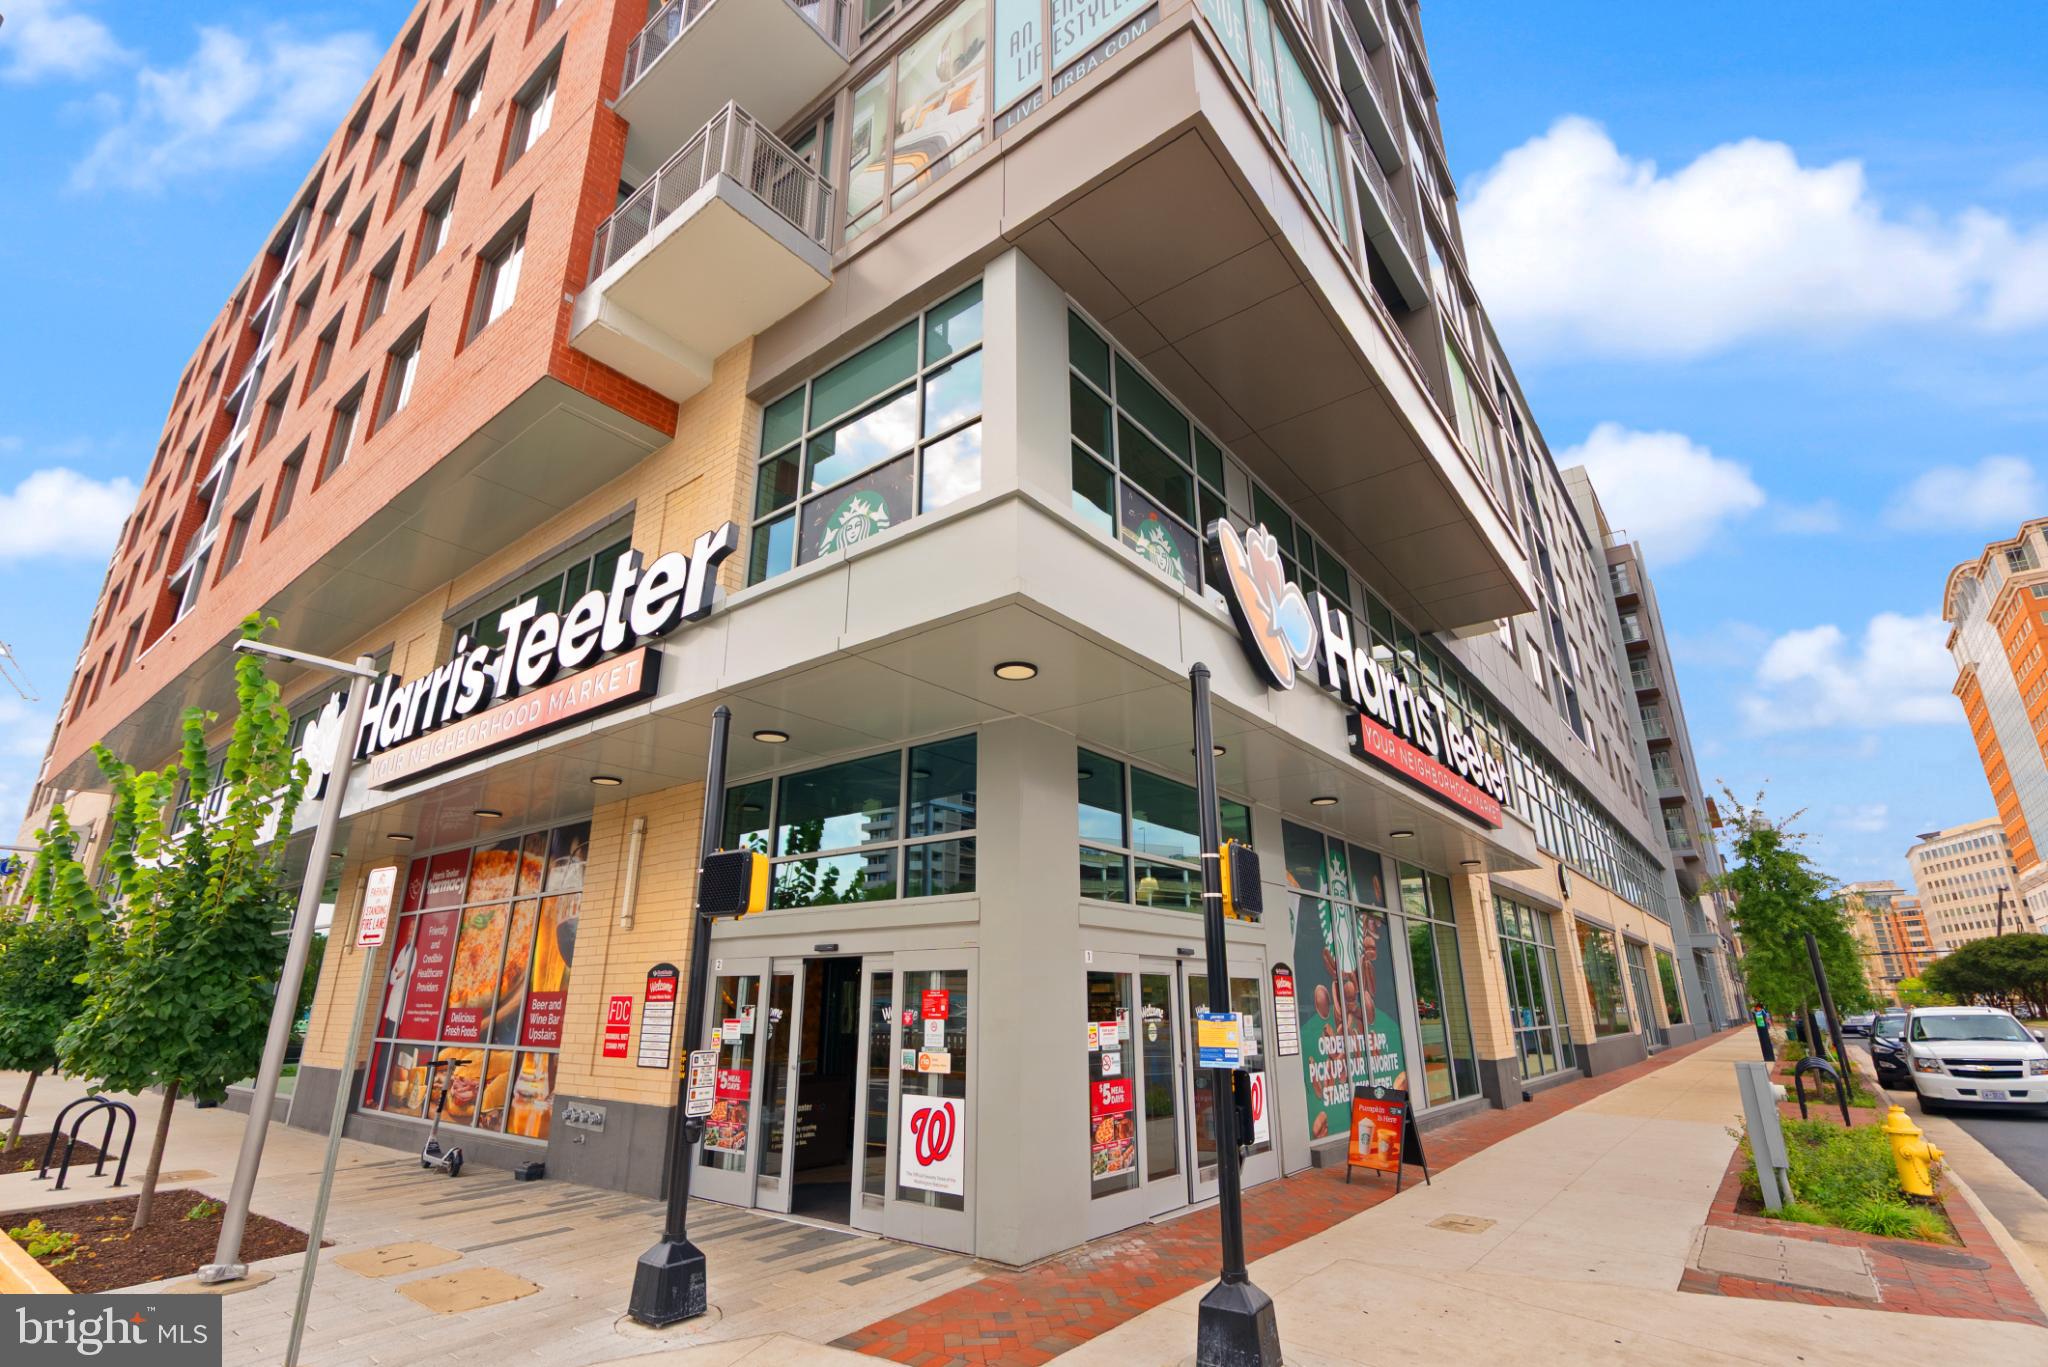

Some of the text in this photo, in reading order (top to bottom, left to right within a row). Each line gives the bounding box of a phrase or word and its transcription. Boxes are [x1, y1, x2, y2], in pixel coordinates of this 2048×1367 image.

[354, 520, 738, 759] Harris Teeter
[1312, 591, 1511, 807] Harris Teeter
[371, 658, 642, 783] YOUR NEIGHBORHOOD MARKET
[1364, 723, 1396, 759] YOUR
[1399, 745, 1473, 805] NEIGHBORHOOD
[649, 978, 673, 993] Welcome
[531, 998, 562, 1010] Beer and
[609, 1000, 631, 1021] FDC
[1141, 1003, 1164, 1019] Welcome
[450, 1012, 476, 1023] Delicious
[529, 1013, 561, 1025] Wine Bar
[444, 1025, 478, 1038] Fresh Foods
[528, 1027, 557, 1042] Upstairs
[727, 1074, 741, 1083] MEAL
[1308, 1060, 1331, 1083] PICK
[1330, 1059, 1343, 1079] UP
[726, 1082, 741, 1091] DAYS
[1099, 1082, 1125, 1106] $5 MEAL
[1110, 1094, 1125, 1105] DAYS
[1358, 1104, 1385, 1115] Pumpkin
[1384, 1115, 1398, 1124] Here
[910, 1101, 956, 1167] W
